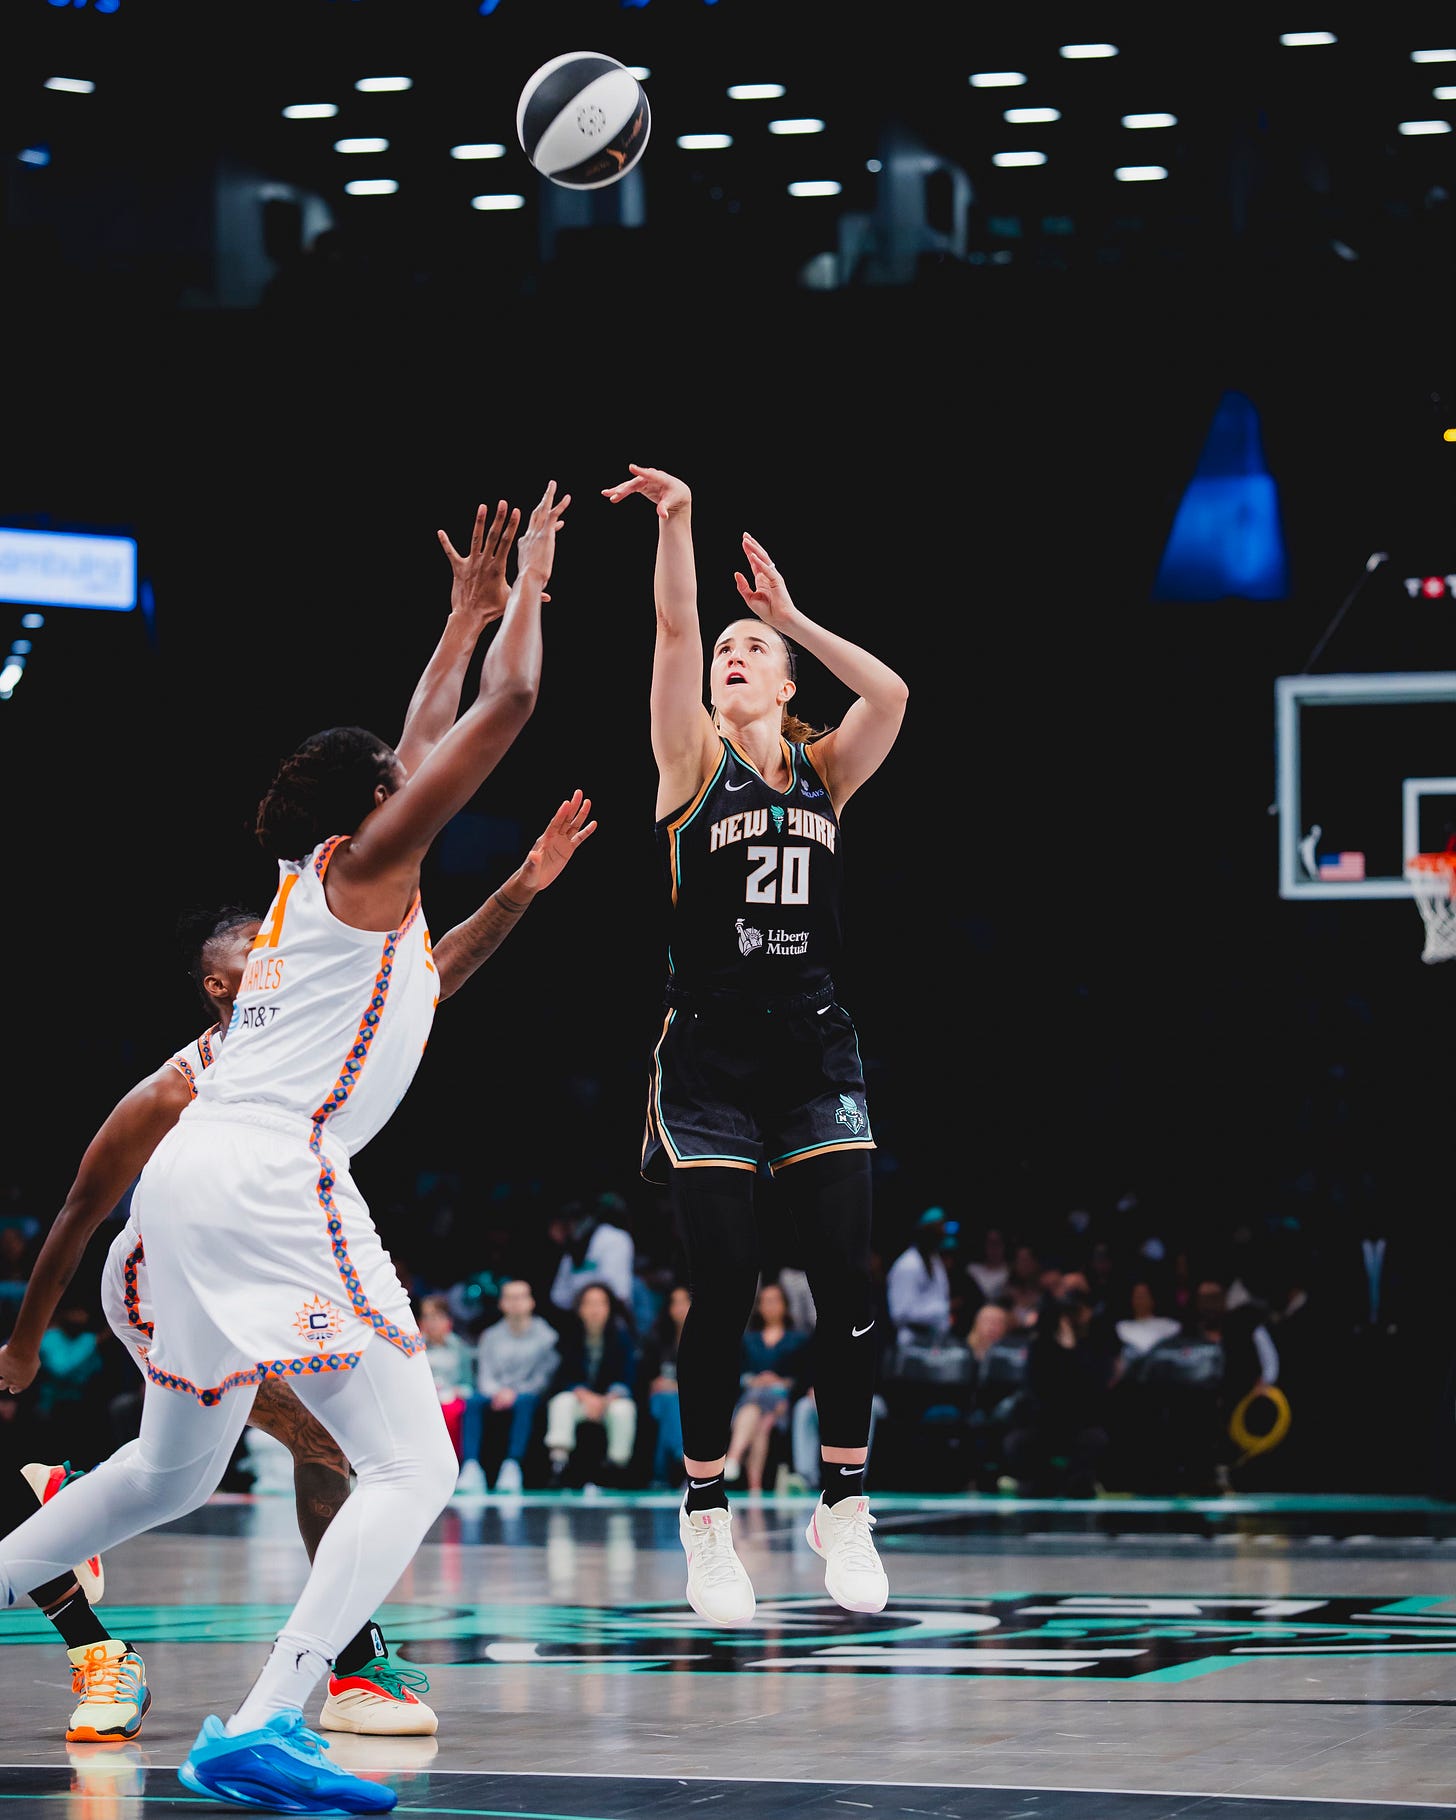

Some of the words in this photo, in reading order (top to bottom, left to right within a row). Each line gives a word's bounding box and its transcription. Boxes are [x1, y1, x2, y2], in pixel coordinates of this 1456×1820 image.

[710, 808, 768, 853] NEW
[787, 807, 836, 855] YORK
[745, 845, 811, 905] 20
[767, 929, 810, 942] Liberty
[766, 941, 809, 955] Mutual
[240, 1006, 280, 1029] AT&T
[309, 1313, 328, 1330] C
